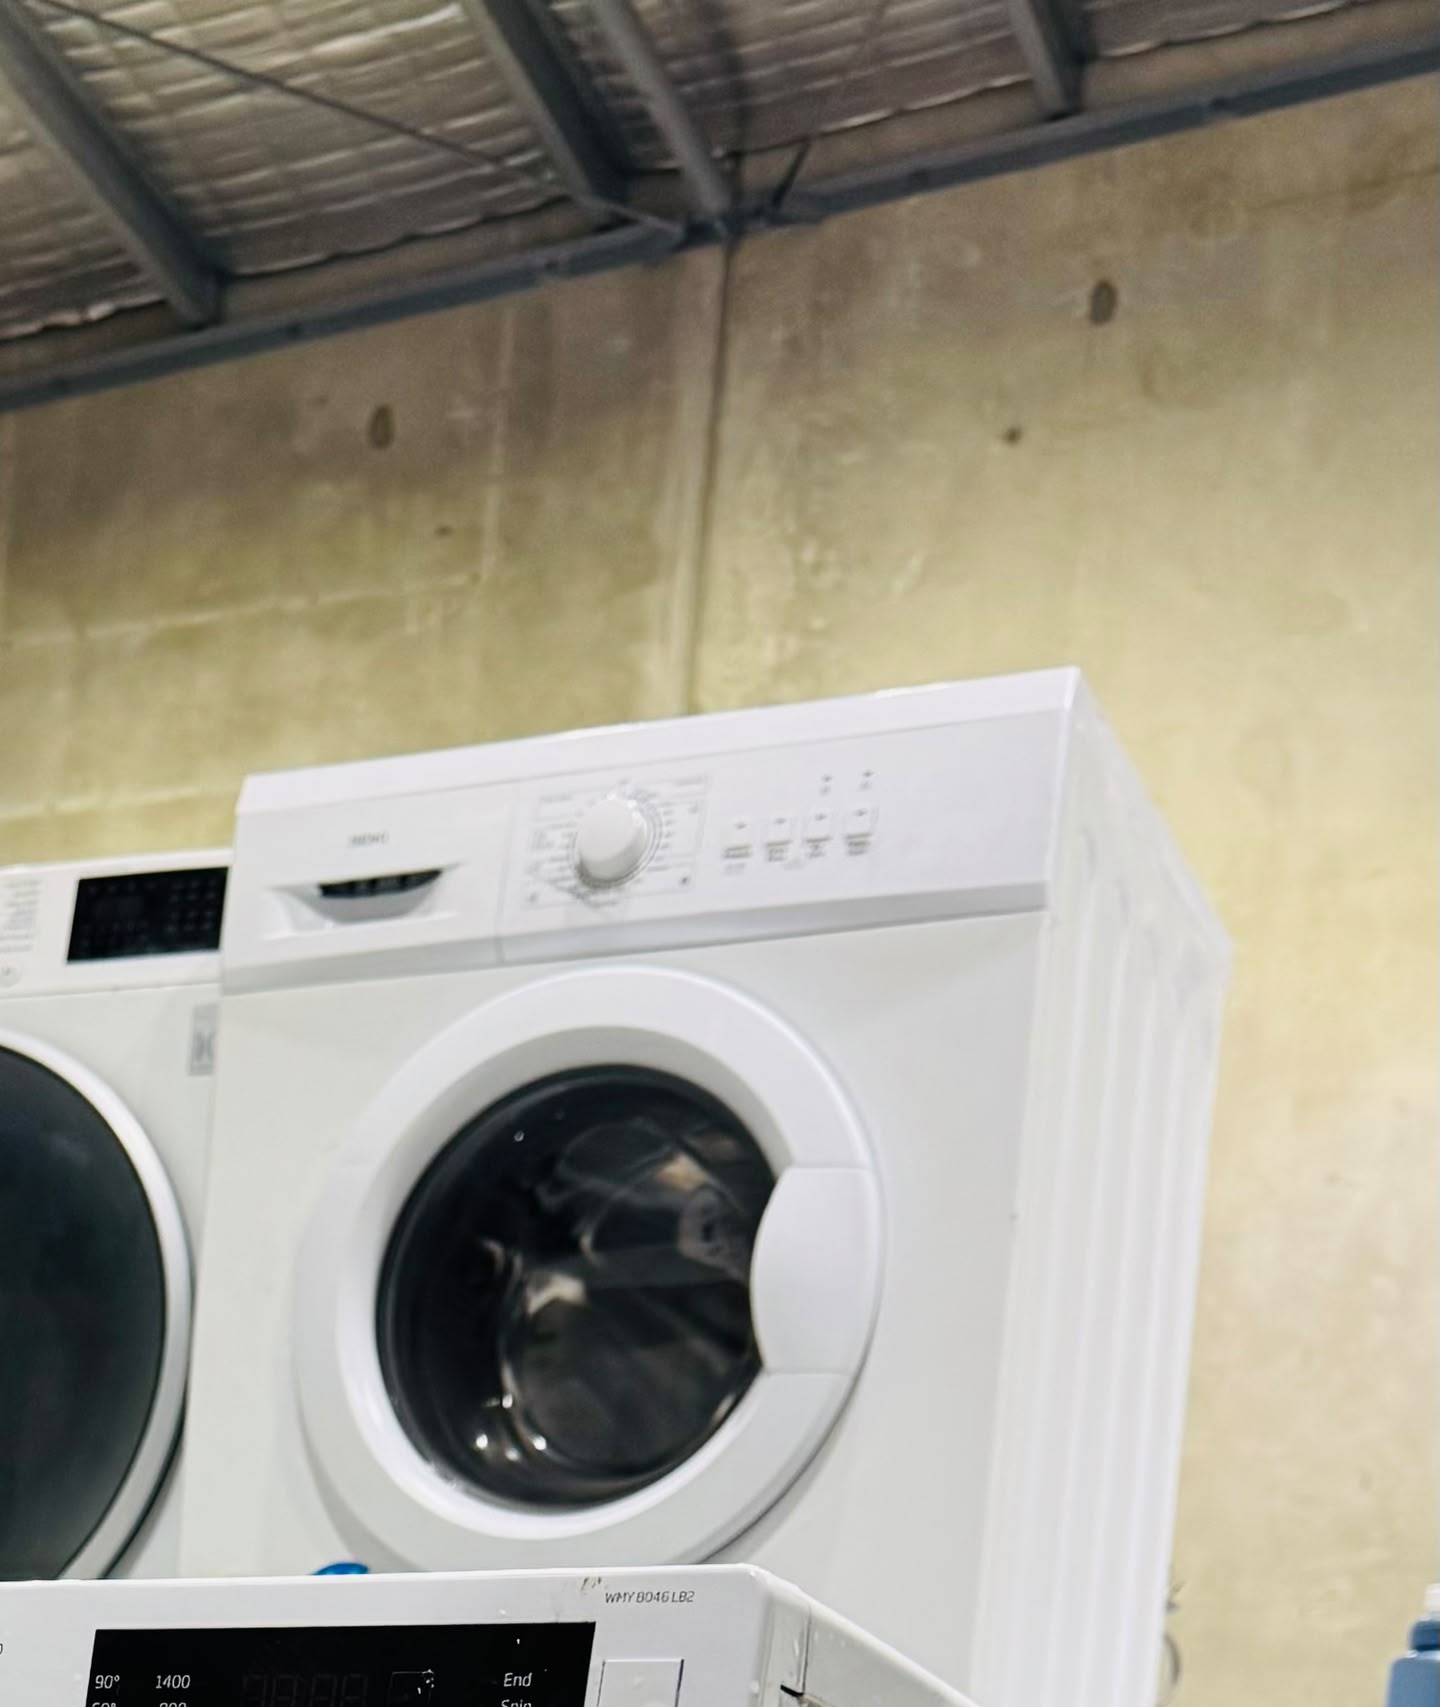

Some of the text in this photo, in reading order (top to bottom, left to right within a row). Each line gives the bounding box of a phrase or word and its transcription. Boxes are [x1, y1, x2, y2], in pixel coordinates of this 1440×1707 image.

[671, 1590, 696, 1603] LB2
[95, 1674, 121, 1690] 90°
[155, 1674, 191, 1689] 1400
[503, 1672, 533, 1688] End
